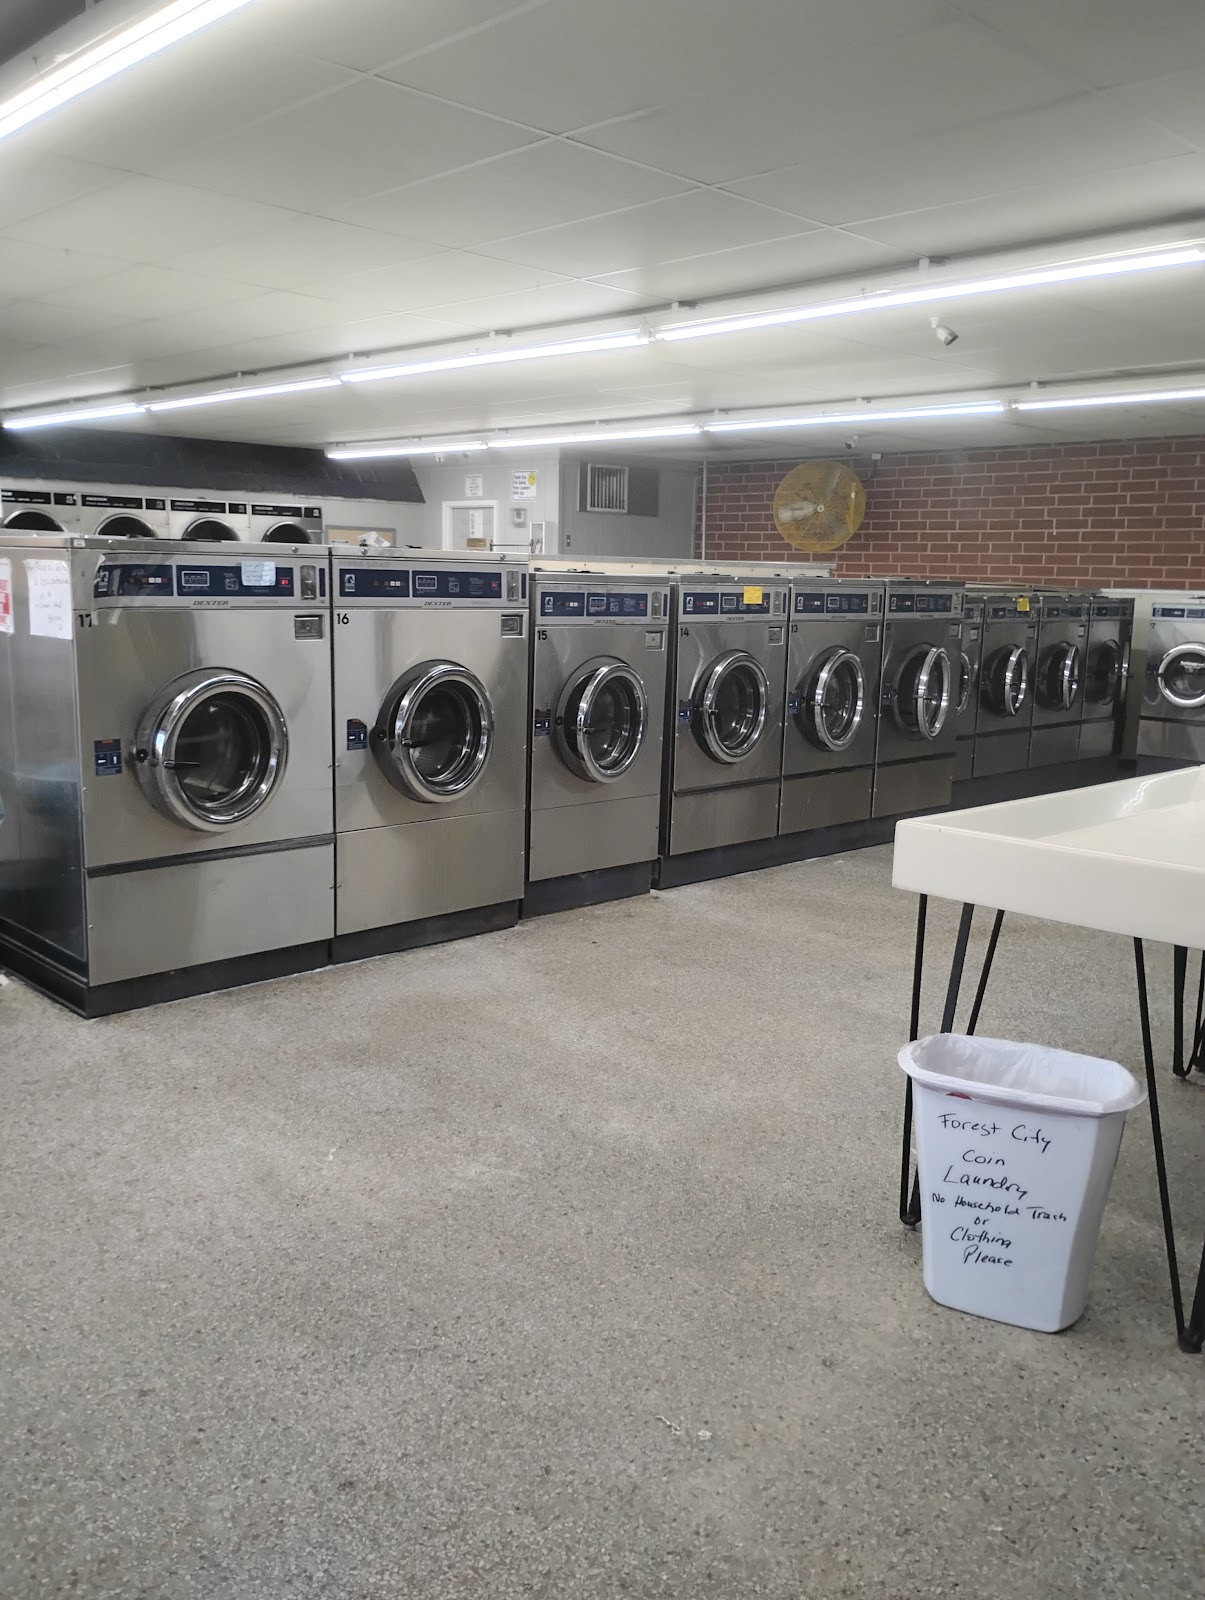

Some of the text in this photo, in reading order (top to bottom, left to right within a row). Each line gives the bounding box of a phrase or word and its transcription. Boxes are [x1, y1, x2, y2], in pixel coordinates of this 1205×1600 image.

[78, 613, 92, 628] 17
[336, 613, 350, 625] 16
[537, 630, 548, 640] 15
[680, 627, 689, 637] 14
[791, 624, 799, 633] 13
[938, 1112, 1051, 1153] Forest City
[962, 1149, 1005, 1166] Coin
[943, 1165, 1029, 1201] Laundry
[931, 1192, 1068, 1223] No Household Trash
[973, 1216, 991, 1226] or
[963, 1243, 1014, 1267] Please
